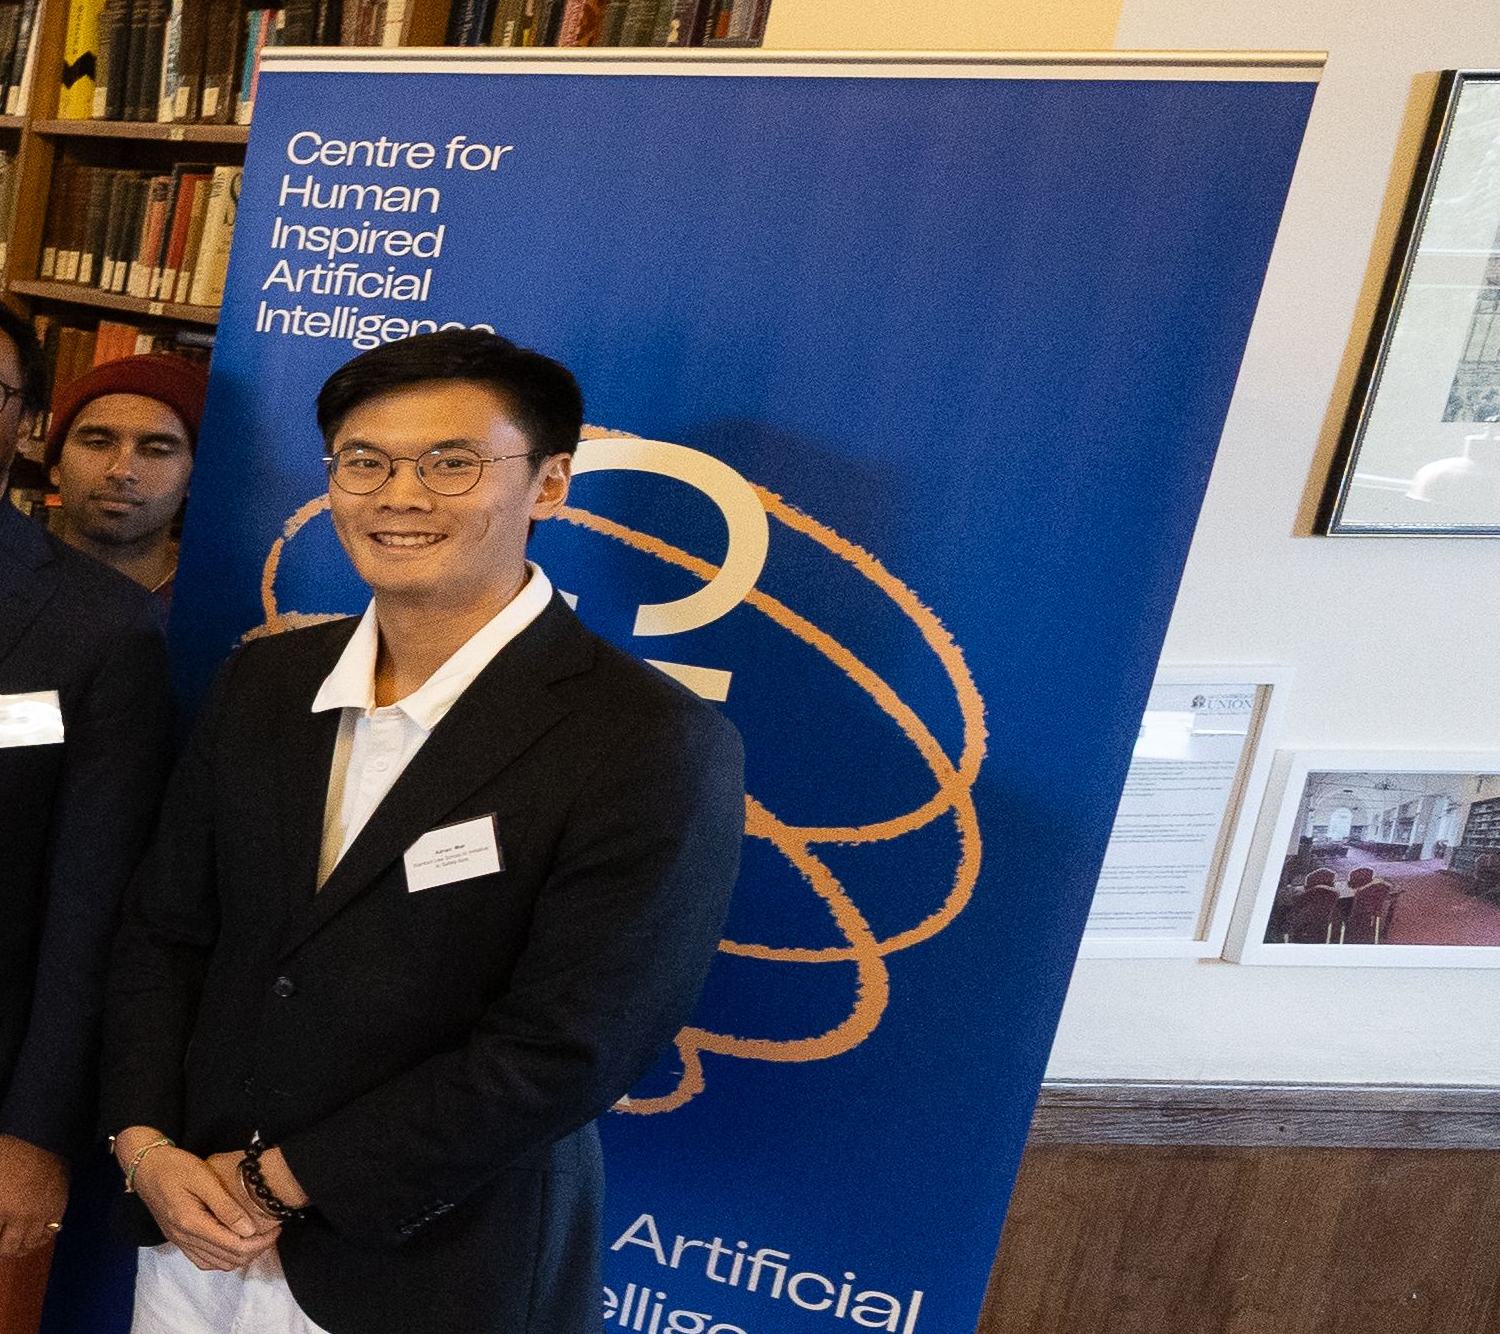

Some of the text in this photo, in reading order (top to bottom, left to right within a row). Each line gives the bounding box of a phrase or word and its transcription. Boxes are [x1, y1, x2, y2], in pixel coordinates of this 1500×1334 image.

[287, 130, 513, 171] Centre for
[278, 174, 441, 214] Human
[271, 217, 446, 260] Inspired
[262, 259, 433, 302] Artificial
[255, 300, 496, 350] Intelligen
